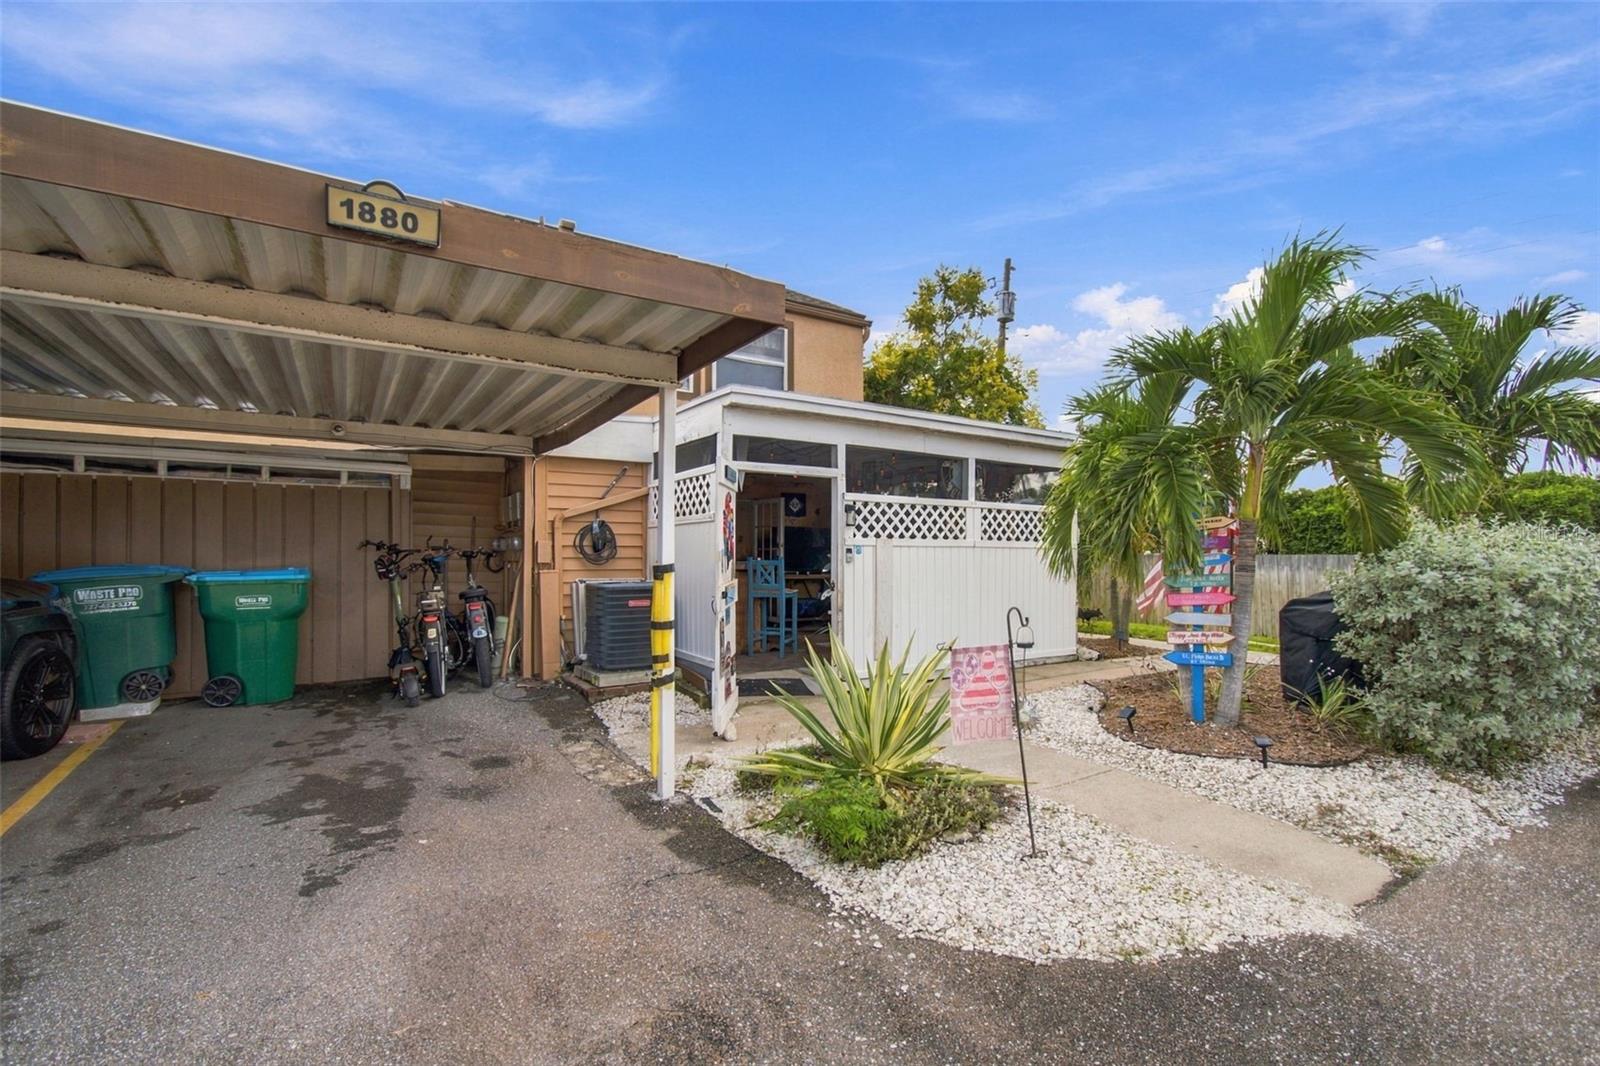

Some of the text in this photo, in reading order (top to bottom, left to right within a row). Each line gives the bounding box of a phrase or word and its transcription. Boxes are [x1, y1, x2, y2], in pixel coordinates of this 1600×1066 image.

[339, 198, 419, 233] 1880
[77, 588, 139, 600] WASTE PRO
[953, 716, 1010, 741] WELCOME
